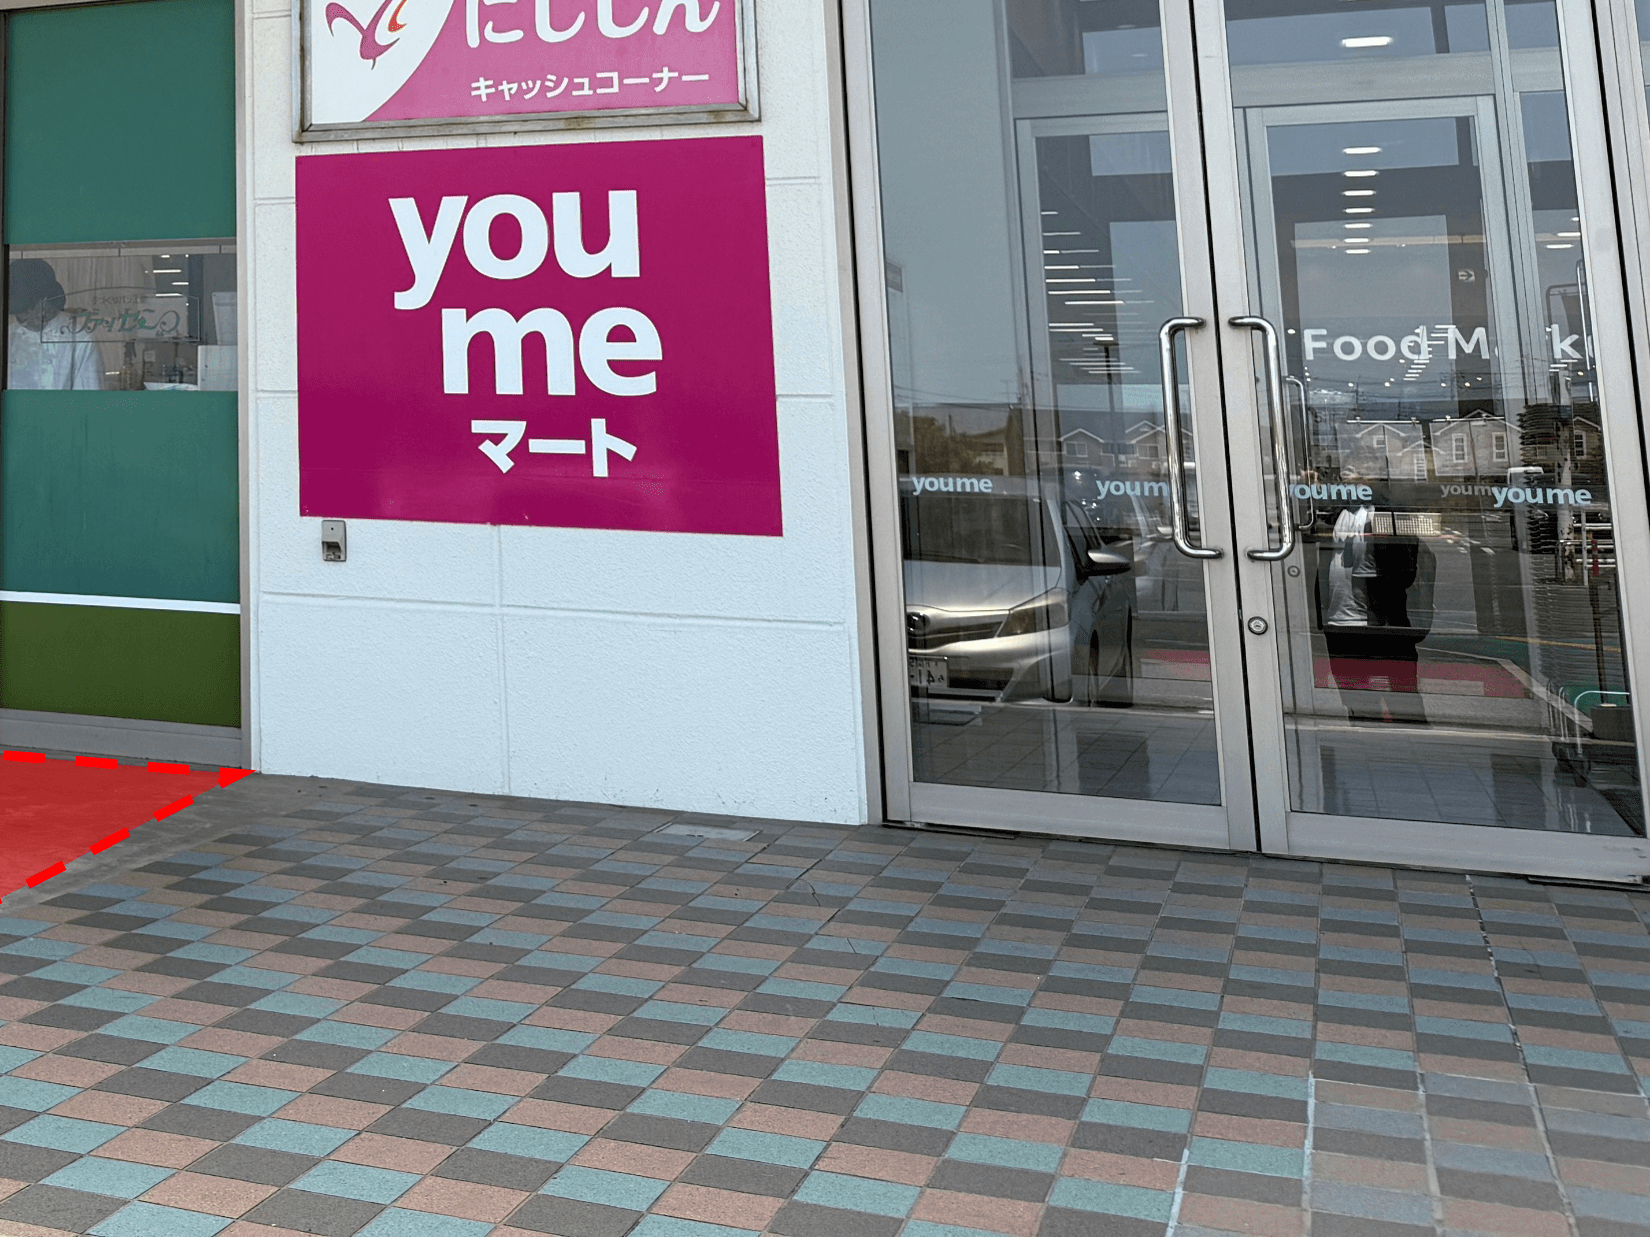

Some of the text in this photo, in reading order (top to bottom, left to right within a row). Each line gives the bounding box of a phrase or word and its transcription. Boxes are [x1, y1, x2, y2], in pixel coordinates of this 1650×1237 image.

[470, 67, 709, 102] キャッシュコーナー
[388, 190, 640, 310] you
[441, 307, 663, 396] me
[1303, 325, 1427, 361] Food
[471, 418, 637, 477] マート
